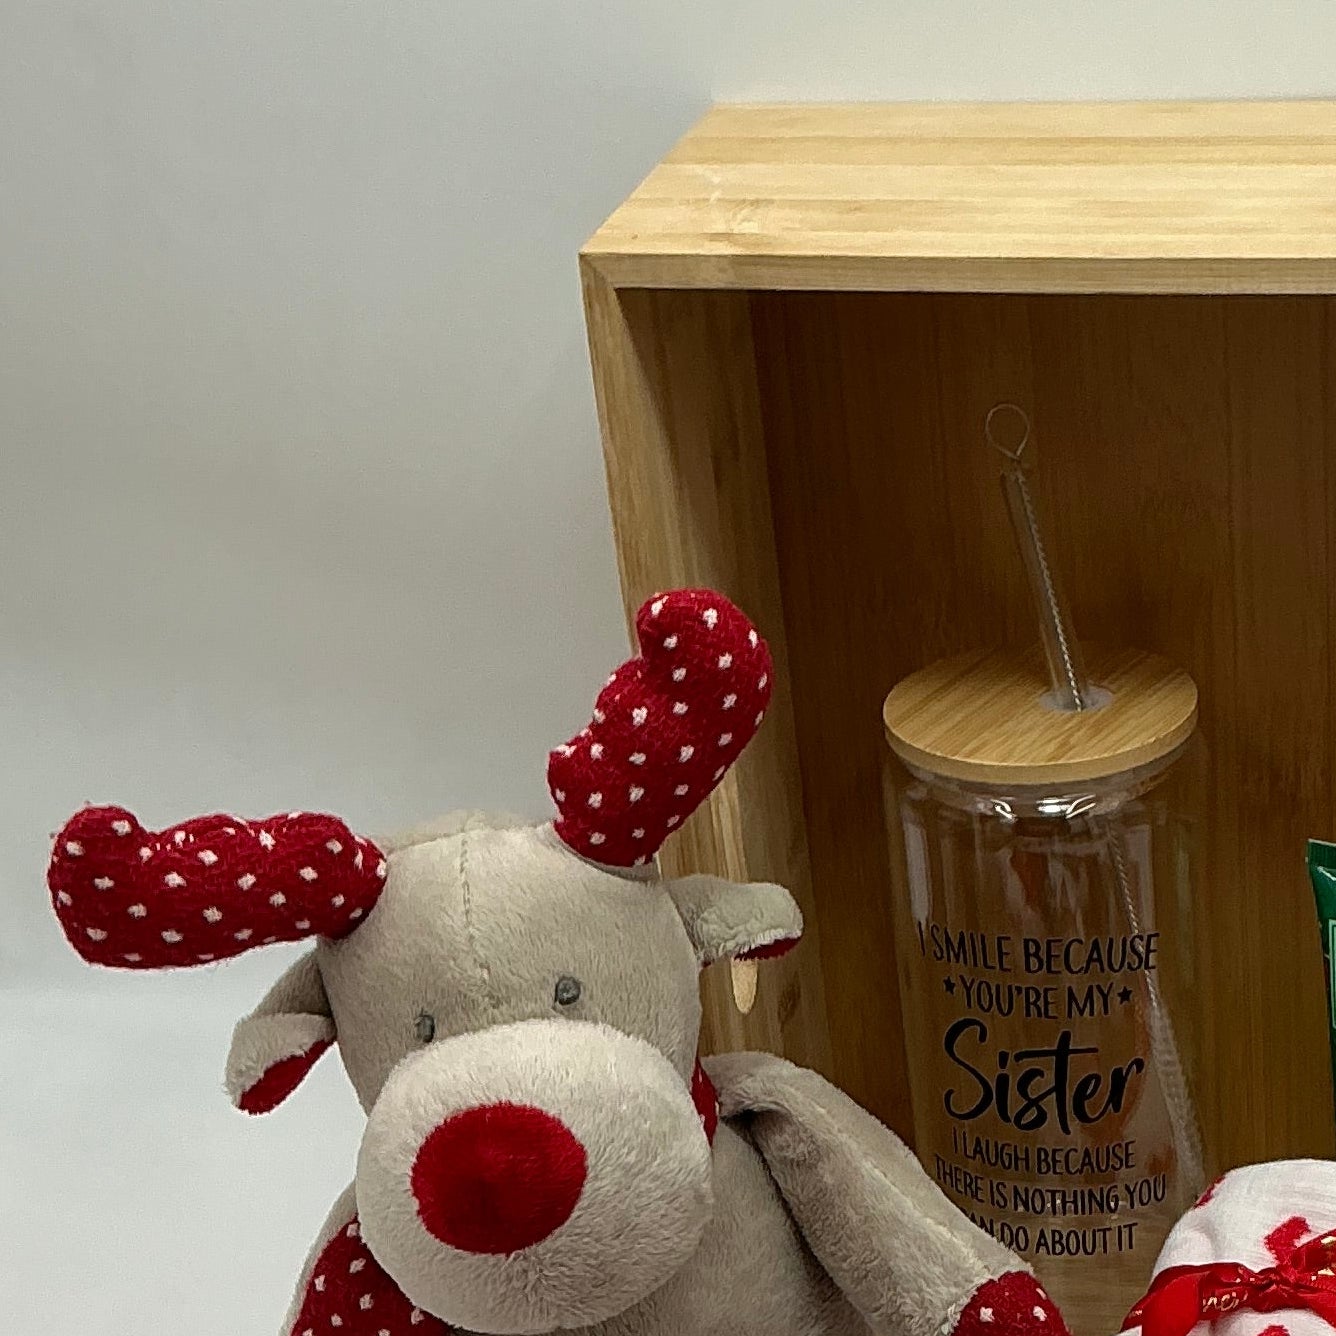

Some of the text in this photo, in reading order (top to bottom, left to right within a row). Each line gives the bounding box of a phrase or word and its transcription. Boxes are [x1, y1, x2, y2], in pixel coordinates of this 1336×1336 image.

[918, 920, 1160, 975] I SMILE BECAUSE
[1066, 983, 1114, 1019] MY
[944, 1018, 1145, 1135] Sister
[952, 1127, 1137, 1175] I LAUGH BECAUSE
[935, 1154, 1167, 1217] THERE IS NOTHING YOU
[1036, 1227, 1112, 1256] ABOUT
[1116, 1223, 1138, 1251] IT
